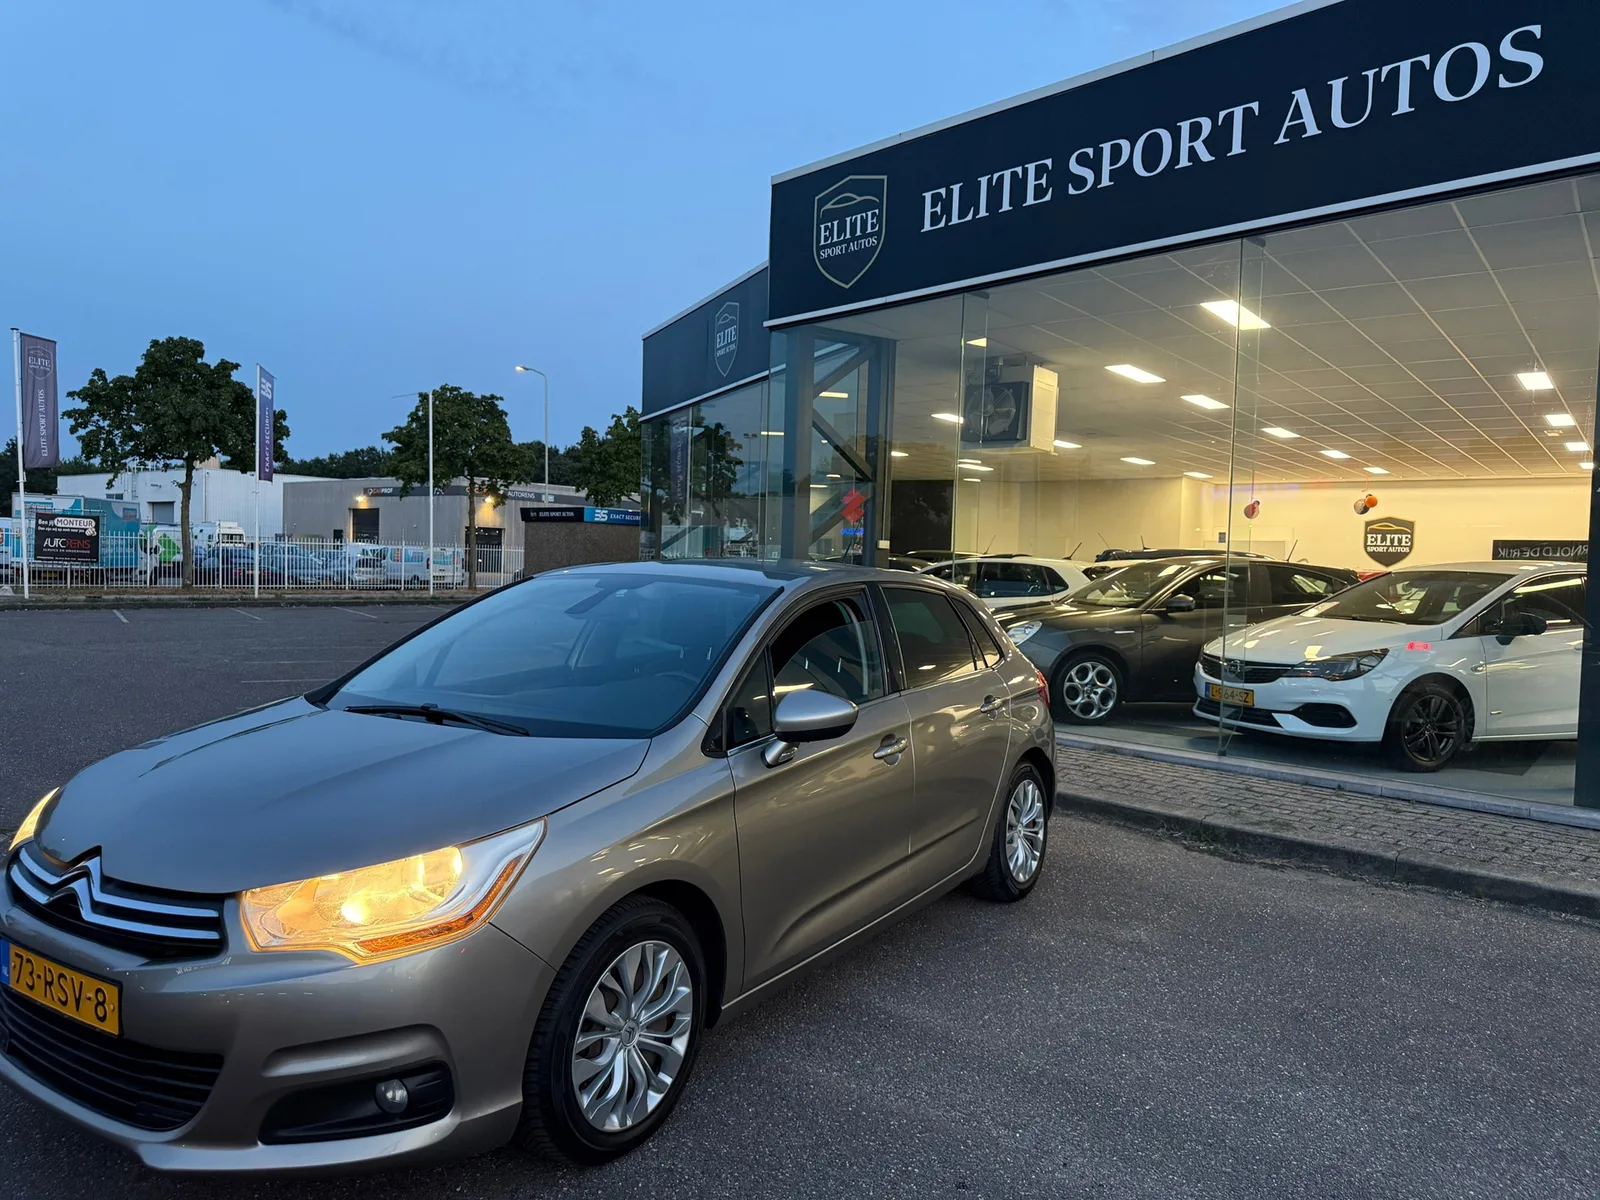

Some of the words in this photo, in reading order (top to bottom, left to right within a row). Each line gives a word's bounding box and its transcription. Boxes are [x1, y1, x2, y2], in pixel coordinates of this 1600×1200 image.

[920, 157, 1053, 233] ELITE
[1066, 100, 1260, 195] SPORT
[1274, 24, 1545, 145] AUTOS
[819, 208, 880, 246] ELITE
[819, 243, 847, 260] SPORT
[848, 235, 878, 253] AUTOS
[716, 325, 737, 348] ELITE
[28, 356, 51, 368] ELITE
[37, 388, 46, 412] AUTOS
[39, 413, 47, 436] SPORT
[40, 437, 48, 457] ELITE
[507, 491, 535, 499] AUTORENS
[56, 519, 93, 527] MONTEUR
[1366, 534, 1411, 546] ELITE
[14, 952, 108, 1023] 73-RSV-8
